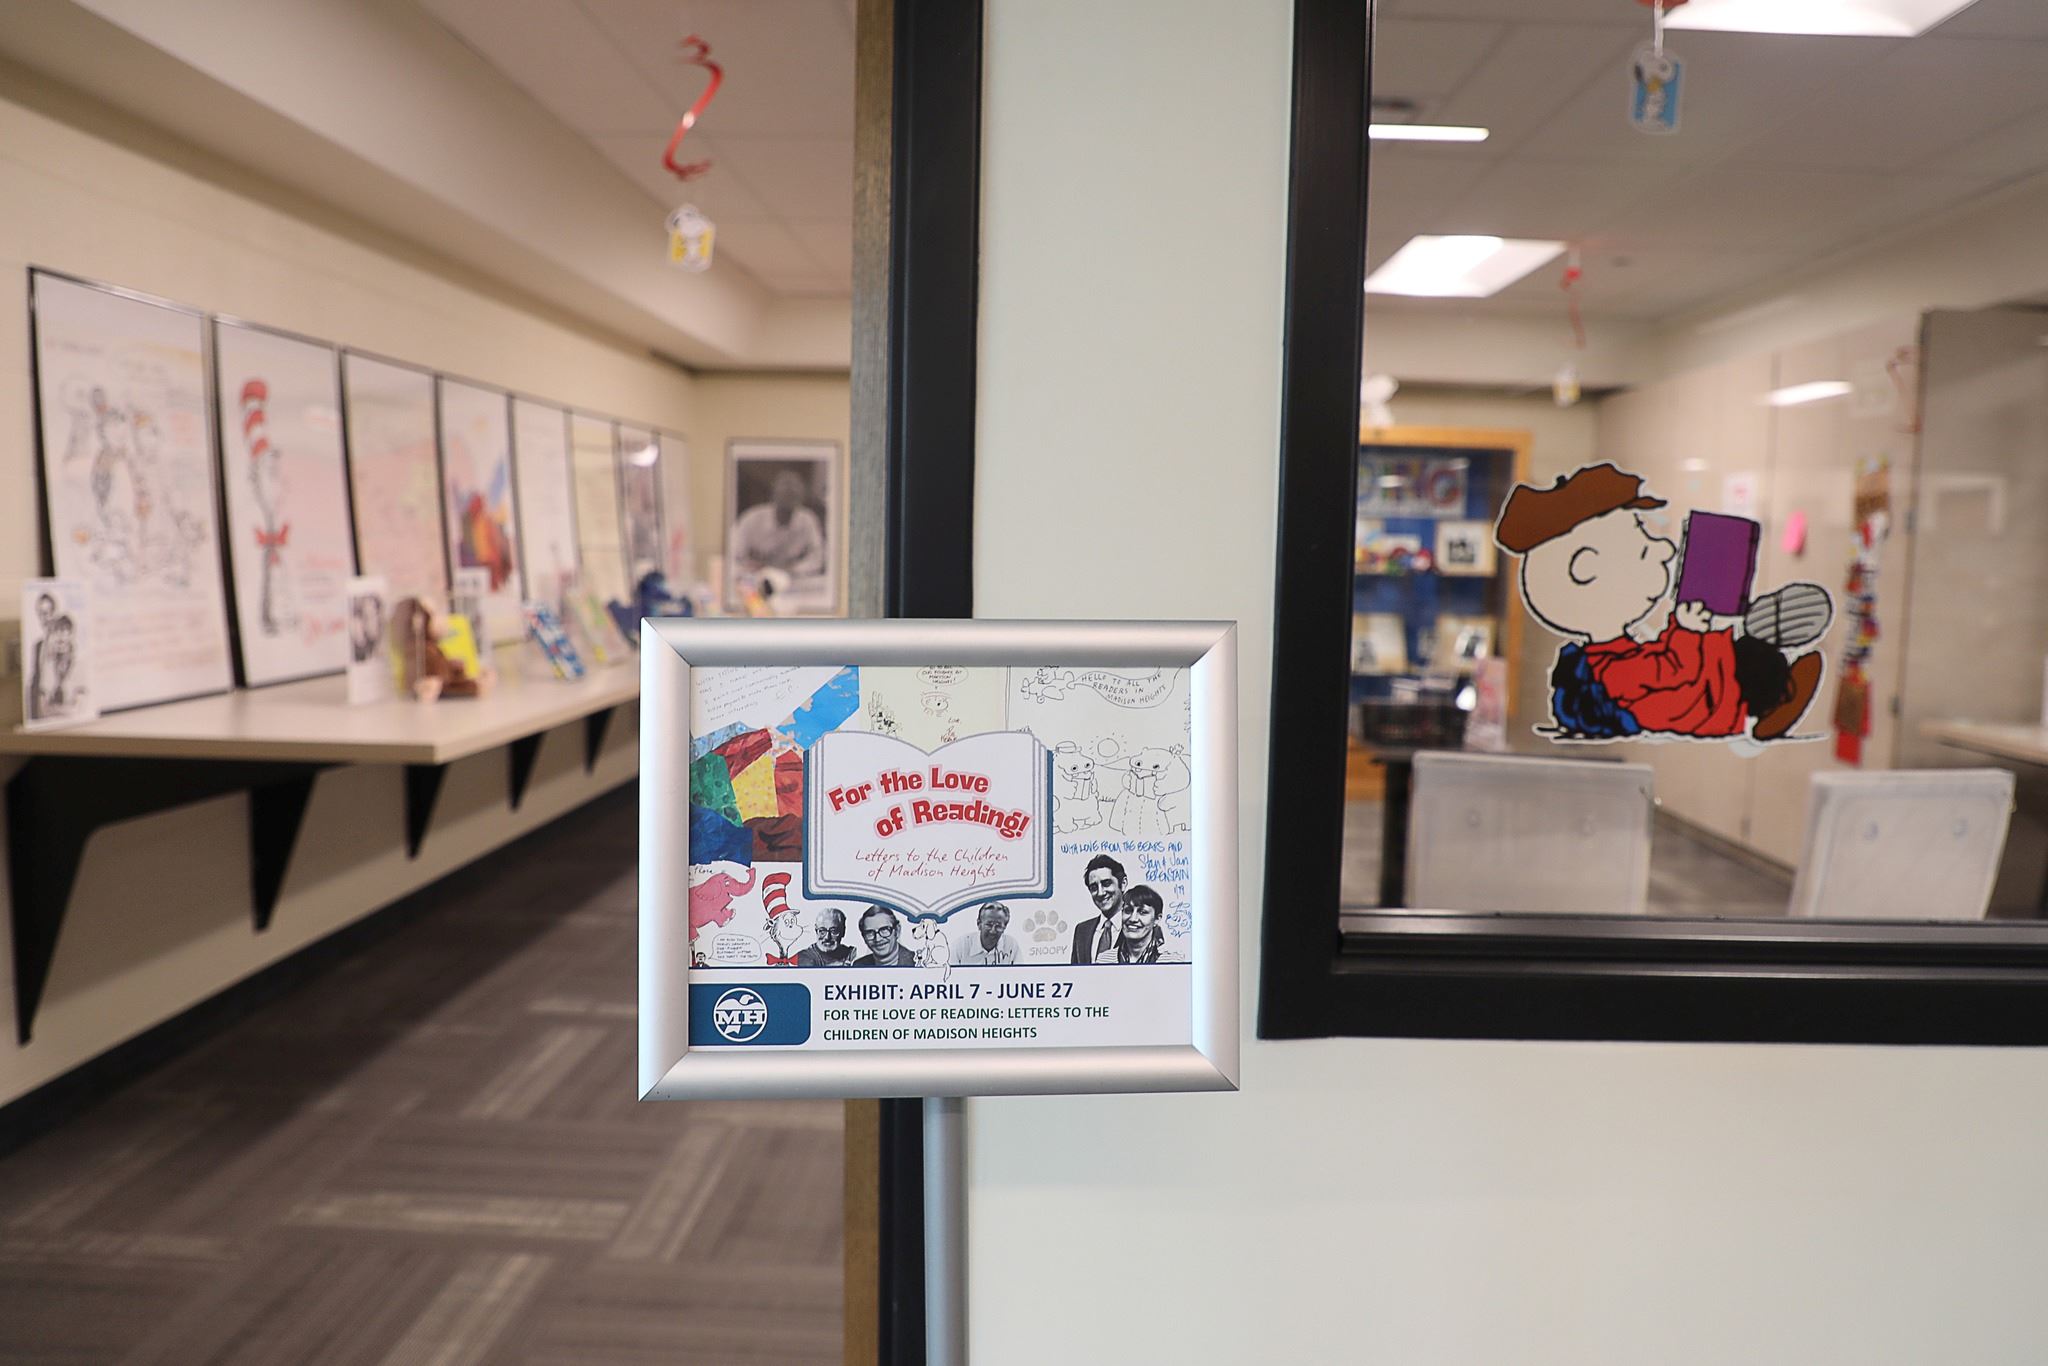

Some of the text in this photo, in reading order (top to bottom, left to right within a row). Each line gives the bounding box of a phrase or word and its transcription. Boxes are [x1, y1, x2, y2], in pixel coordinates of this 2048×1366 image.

[1092, 681, 1129, 695] READERS
[828, 767, 989, 811] For the Love
[876, 799, 1030, 838] of Reading!
[855, 846, 1009, 863] Letters to the Children
[1080, 841, 1100, 853] LOVE
[868, 861, 996, 886] of Madison Heights
[1029, 945, 1068, 957] SNOOPY
[824, 984, 904, 1001] EXHIBIT:
[909, 984, 965, 1000] APRIL
[969, 983, 980, 999] 7
[997, 983, 1046, 999] JUNE
[1051, 982, 1074, 998] 27
[715, 1010, 766, 1024] MH
[824, 1006, 1110, 1021] FOR THE LOVE OF READING: LETTERS TO THE
[824, 1027, 1037, 1041] CHILDREN OF MADISON HEIGHTS
